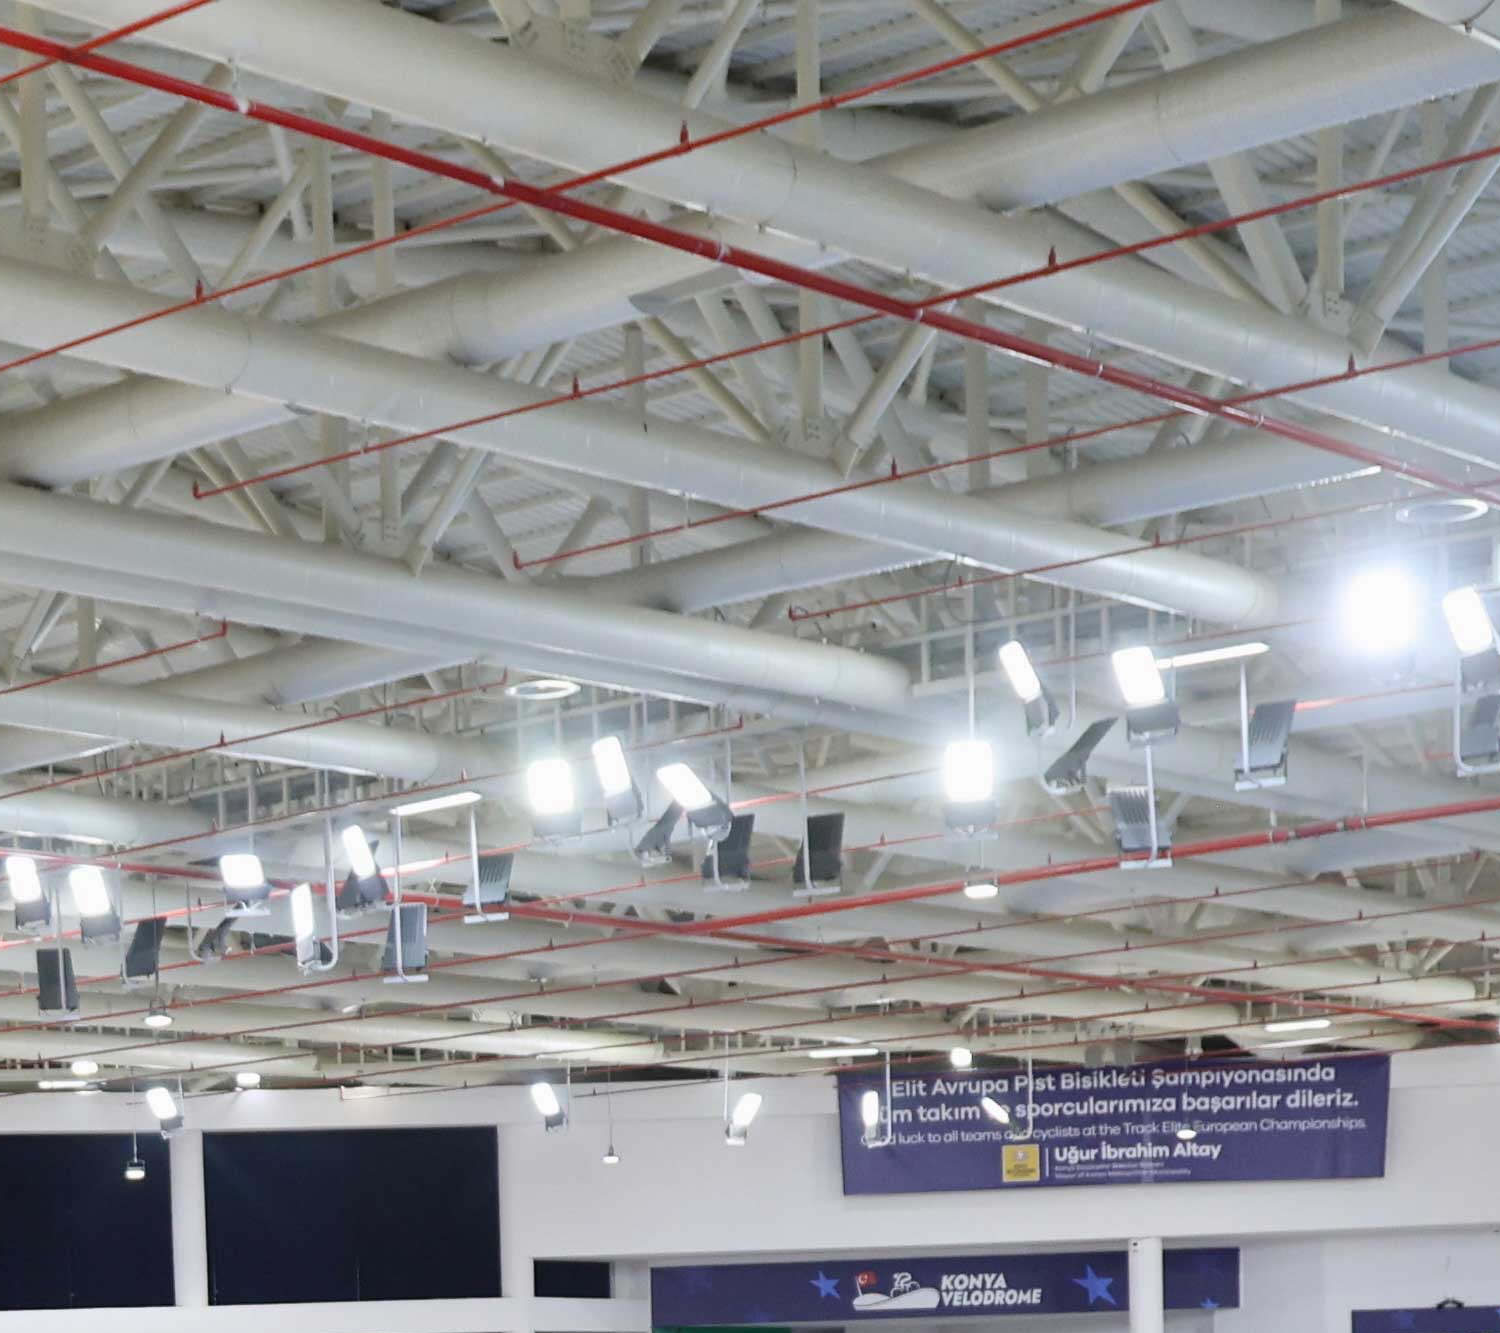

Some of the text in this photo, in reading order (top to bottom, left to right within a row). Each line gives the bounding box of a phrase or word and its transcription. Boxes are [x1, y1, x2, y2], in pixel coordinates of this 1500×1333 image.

[891, 1079, 927, 1098] Elit
[931, 1077, 1009, 1098] Avrupa
[918, 1103, 981, 1122] takım
[1015, 1095, 1176, 1121] sporcularımıza
[1182, 1091, 1281, 1114] başarılar
[1286, 1089, 1359, 1108] dileriz.
[898, 1119, 1257, 1145] luck to all teams cyclists at the Track European
[1054, 1146, 1098, 1165] Uğur
[1101, 1140, 1170, 1160] İbrahim
[1174, 1141, 1221, 1160] Altay
[941, 1272, 1007, 1291] KONYA
[942, 1288, 1042, 1307] VELODROME
